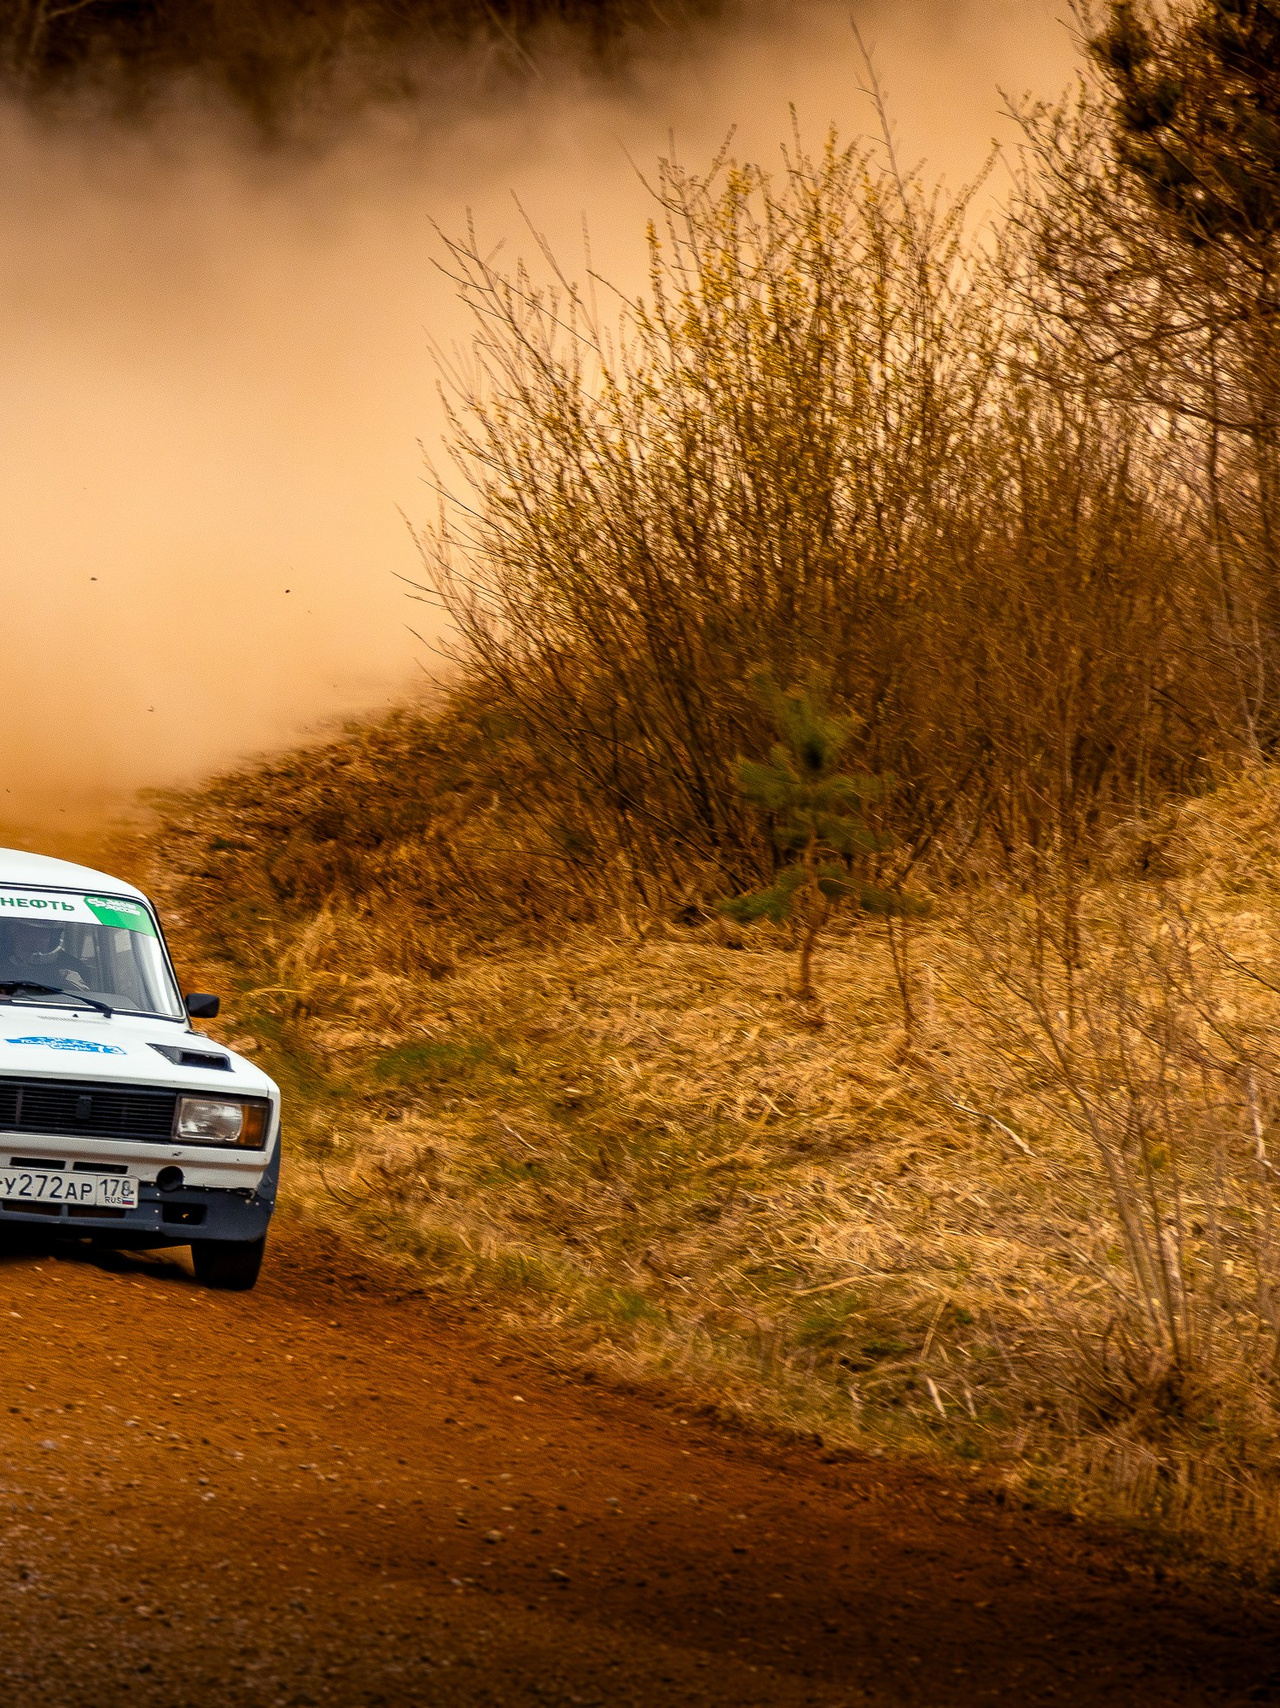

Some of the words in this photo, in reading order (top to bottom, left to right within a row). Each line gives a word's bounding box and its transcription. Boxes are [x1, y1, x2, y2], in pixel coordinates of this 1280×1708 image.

[4, 1174, 93, 1200] У272АР
[99, 1178, 131, 1198] 178
[105, 1196, 122, 1205] RUS
